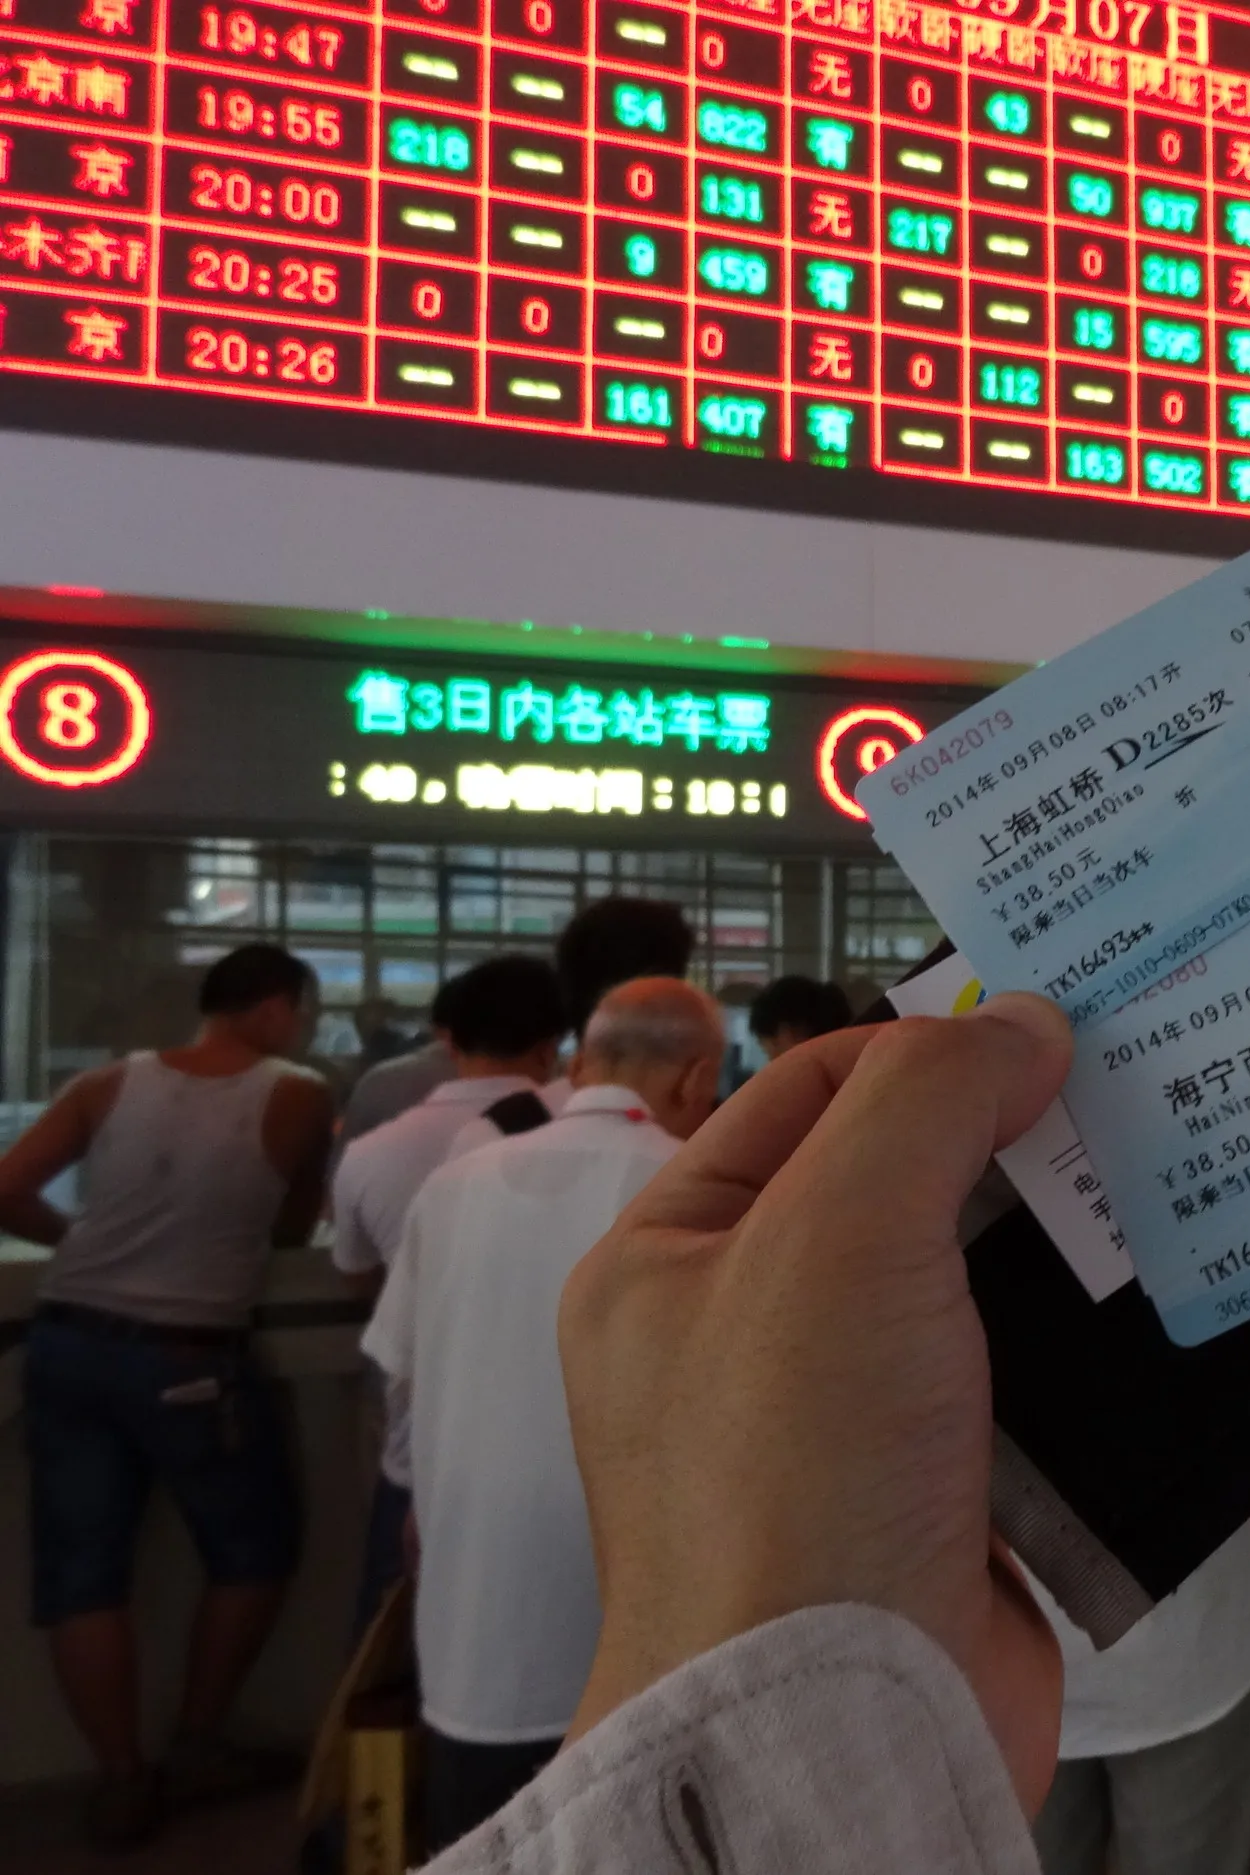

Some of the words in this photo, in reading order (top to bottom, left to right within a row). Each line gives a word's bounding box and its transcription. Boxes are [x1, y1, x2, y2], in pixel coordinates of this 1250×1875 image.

[205, 11, 340, 68] 19:47
[527, 0, 553, 34] 0
[701, 34, 725, 68] 0
[812, 52, 852, 99] 无
[910, 78, 933, 111] 0
[1160, 132, 1182, 163] 0
[0, 52, 131, 117] 京南
[203, 91, 341, 147] 19:55
[389, 119, 470, 170] 218
[629, 166, 655, 199] 0
[701, 175, 763, 222] 131
[812, 192, 853, 239] 无
[889, 209, 952, 254] 217
[1082, 248, 1104, 278] 0
[195, 168, 340, 226] 20:00
[625, 234, 655, 276] 9
[190, 329, 336, 384] 20:26
[192, 249, 338, 305] 20:25
[415, 283, 443, 319] 0
[524, 299, 550, 334] 0
[699, 325, 725, 359] 0
[811, 335, 853, 381] 无
[911, 356, 934, 389] 0
[981, 364, 1040, 406] 112
[1163, 393, 1185, 424] 0
[40, 683, 98, 749] 8
[350, 671, 772, 753] 售3日内各站车票
[1100, 661, 1182, 719] 08:17开
[889, 708, 1014, 798] 6K042079
[979, 766, 1105, 867] 上海虹桥
[1101, 687, 1235, 772] D2285次
[1008, 844, 1156, 952] 限乘当日当次车
